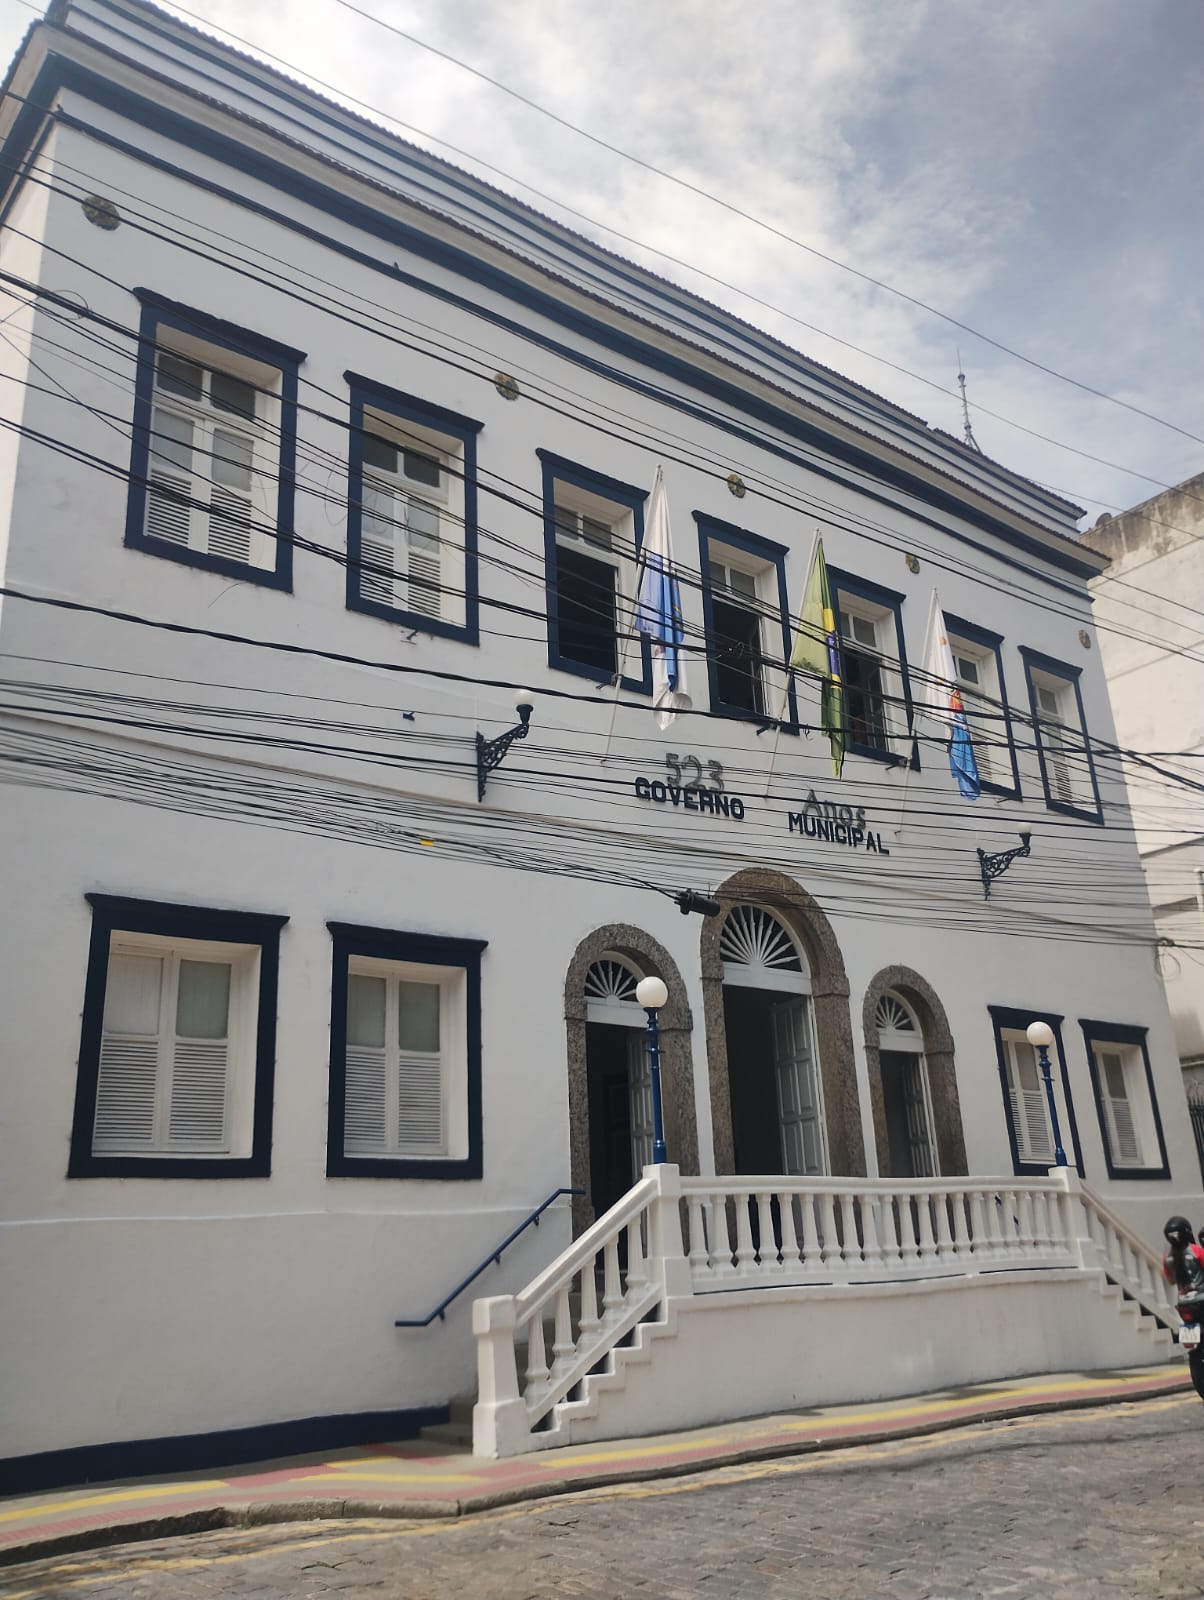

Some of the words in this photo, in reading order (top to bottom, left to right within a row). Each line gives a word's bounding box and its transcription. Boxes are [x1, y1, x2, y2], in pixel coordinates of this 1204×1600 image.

[634, 776, 746, 820] GOVERNO
[787, 811, 890, 856] MUNICIPAL
[665, 752, 725, 792] 523
[801, 788, 866, 830] Anos
